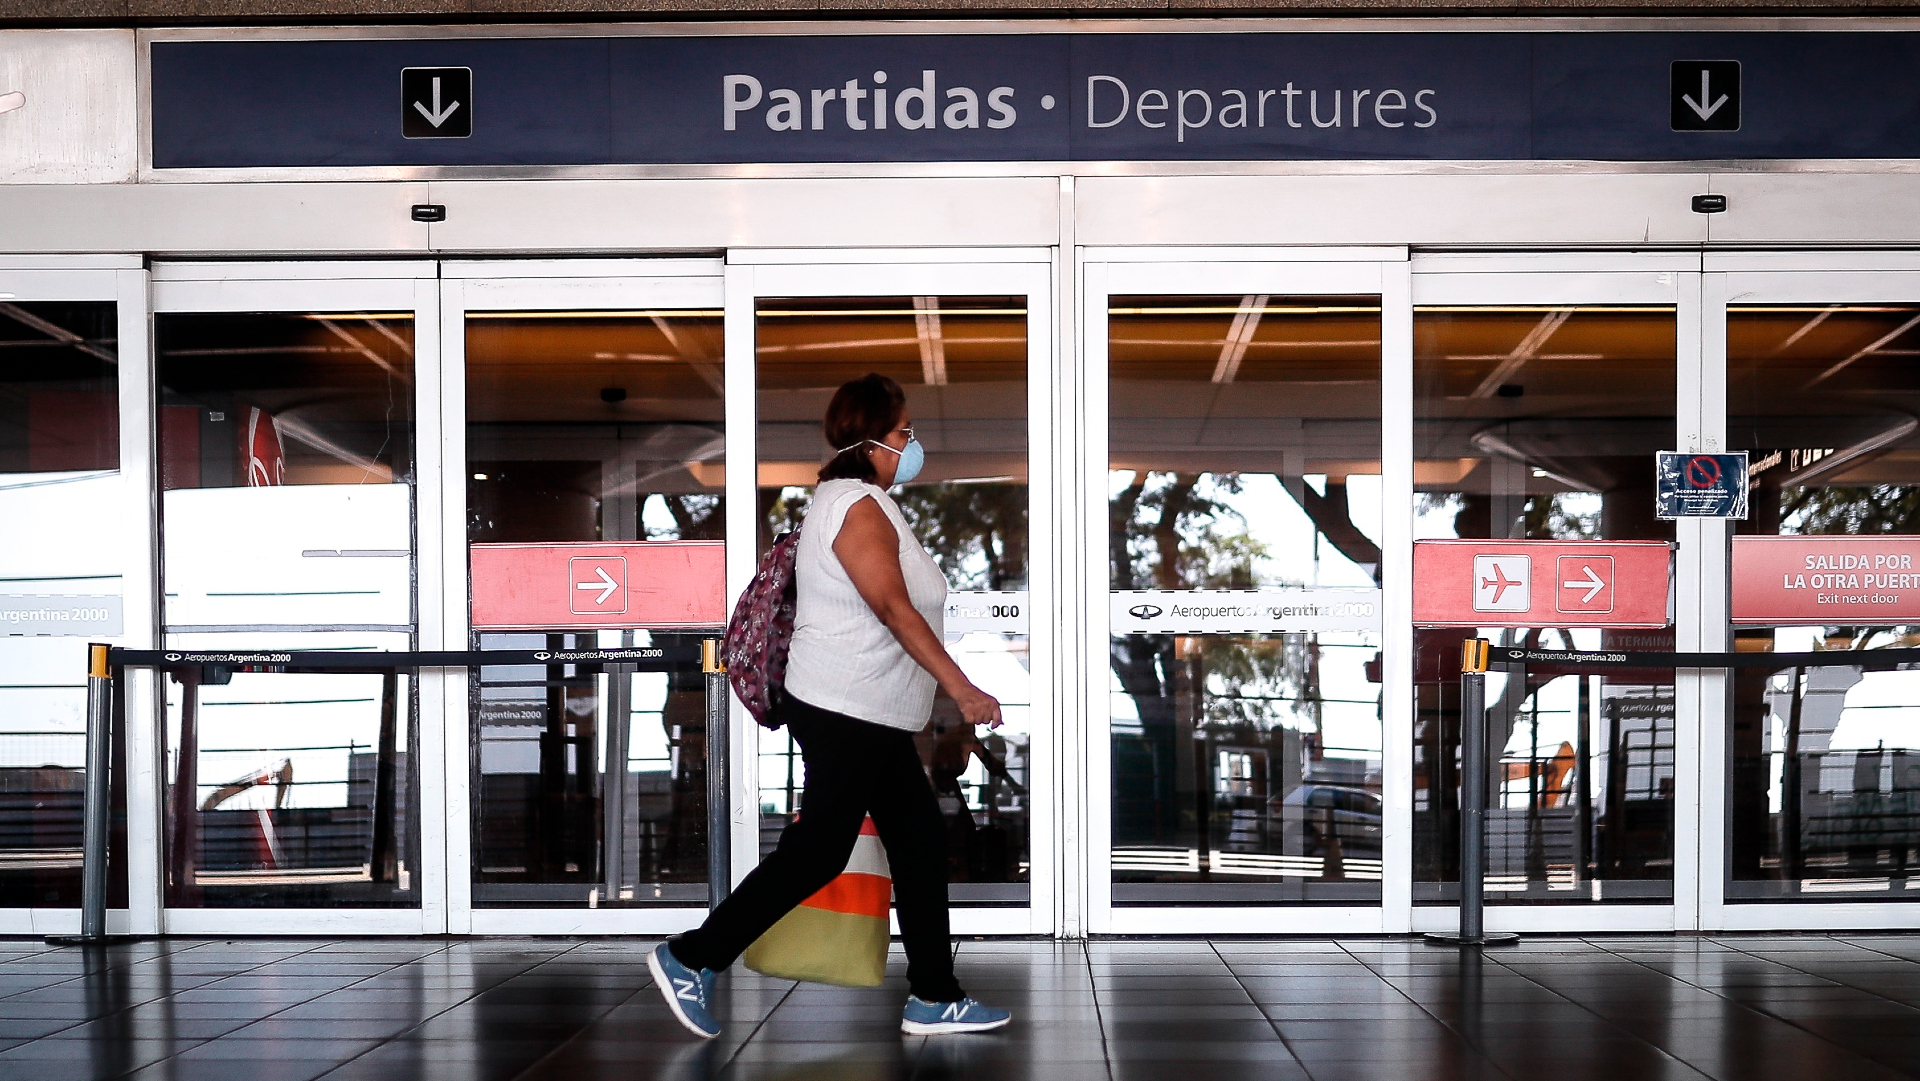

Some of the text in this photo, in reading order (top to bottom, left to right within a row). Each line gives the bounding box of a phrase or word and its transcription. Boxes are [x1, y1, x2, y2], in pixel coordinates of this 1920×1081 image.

[722, 69, 1017, 132] Partidas
[1086, 74, 1438, 143] Departures
[1805, 554, 1912, 570] SALIDA POR
[1783, 573, 1920, 589] LA OTRA PUERT
[1817, 592, 1899, 604] Exit next door
[71, 607, 109, 621] 2000
[1170, 601, 1375, 621] Aeropuertos Argentina 2000
[184, 653, 291, 663] Aeropuertos Argentina 2000
[553, 649, 663, 661] Aeropuertos Argentina 2000
[1526, 651, 1627, 663] Aeropuertos Argentina 2000
[521, 710, 542, 720] 2000
